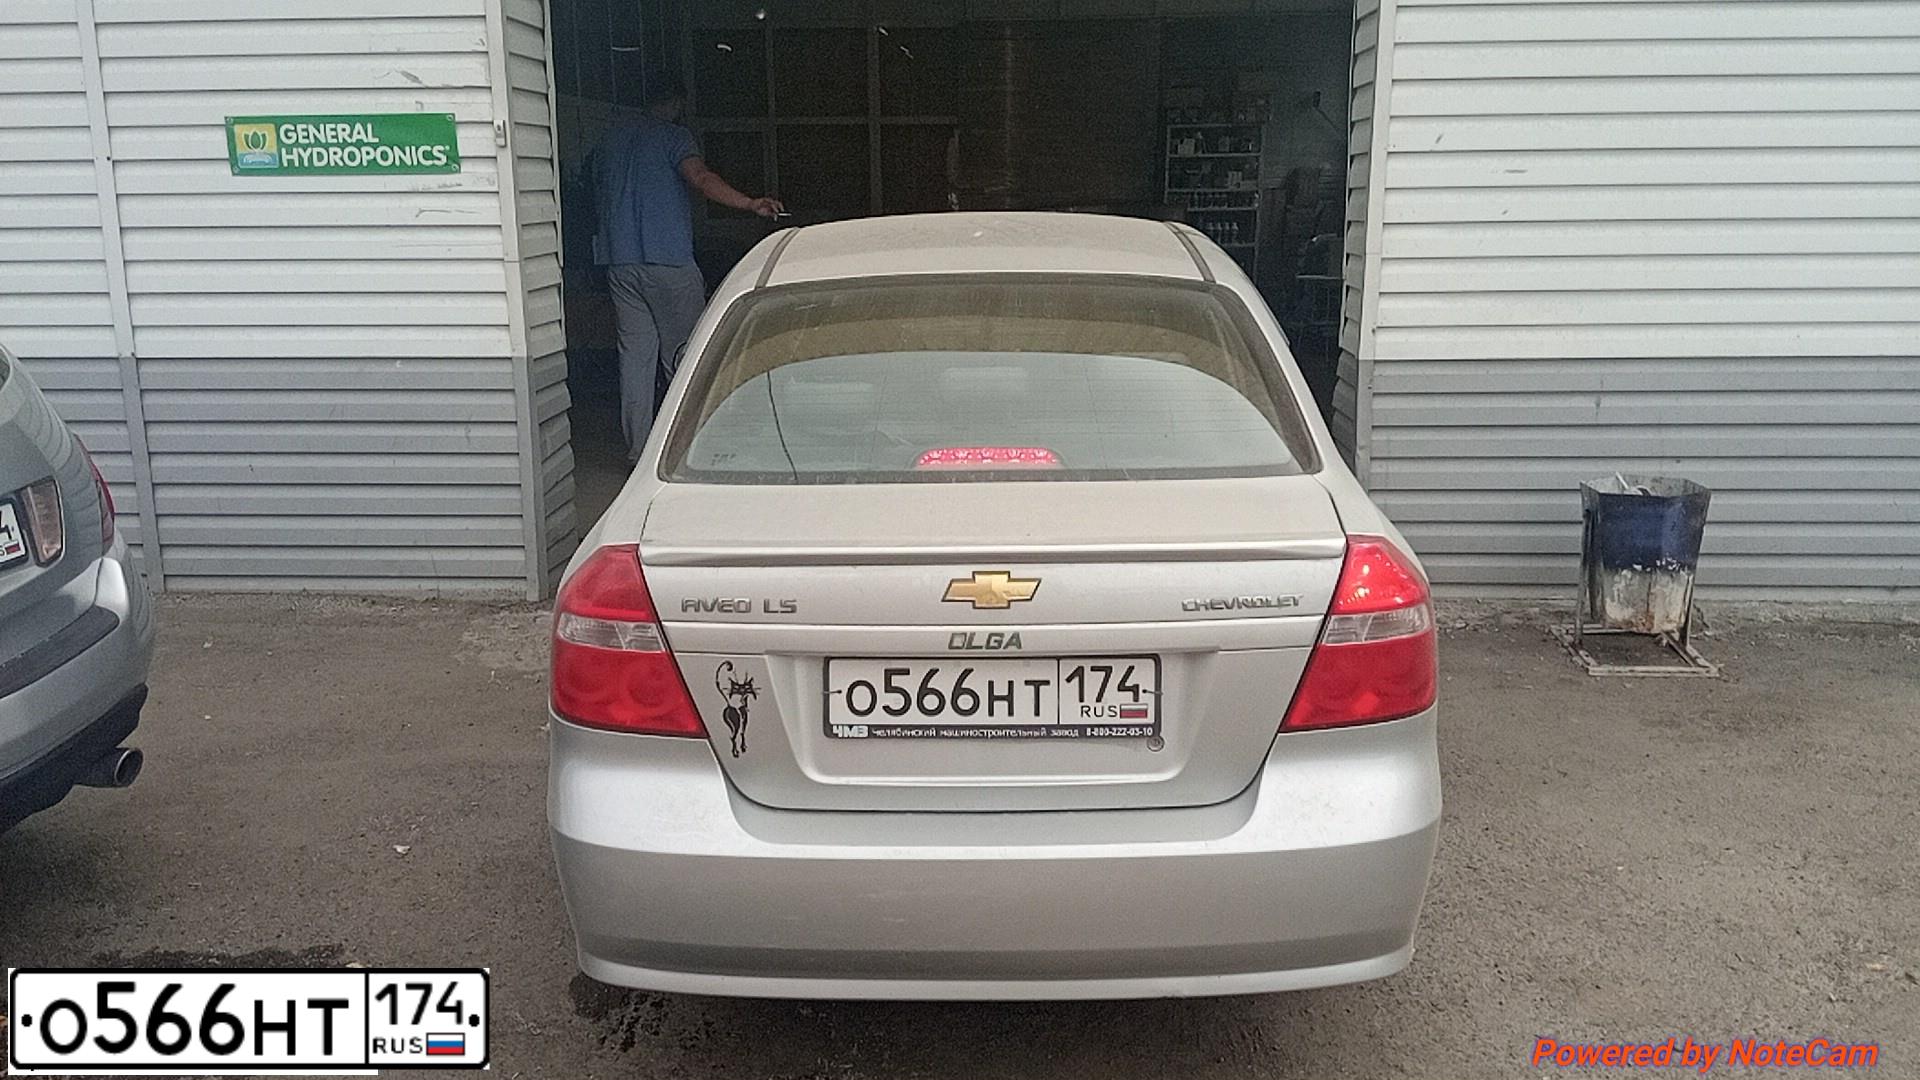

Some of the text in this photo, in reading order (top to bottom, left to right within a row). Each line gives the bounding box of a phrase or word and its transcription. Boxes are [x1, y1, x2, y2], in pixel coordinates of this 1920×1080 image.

[279, 122, 379, 144] GENERAL
[681, 597, 798, 614] AVEO LS
[1181, 593, 1304, 612] CHEVROLET
[948, 631, 1023, 650] OLGA
[1065, 665, 1140, 703] 174
[1080, 705, 1118, 718] RUS
